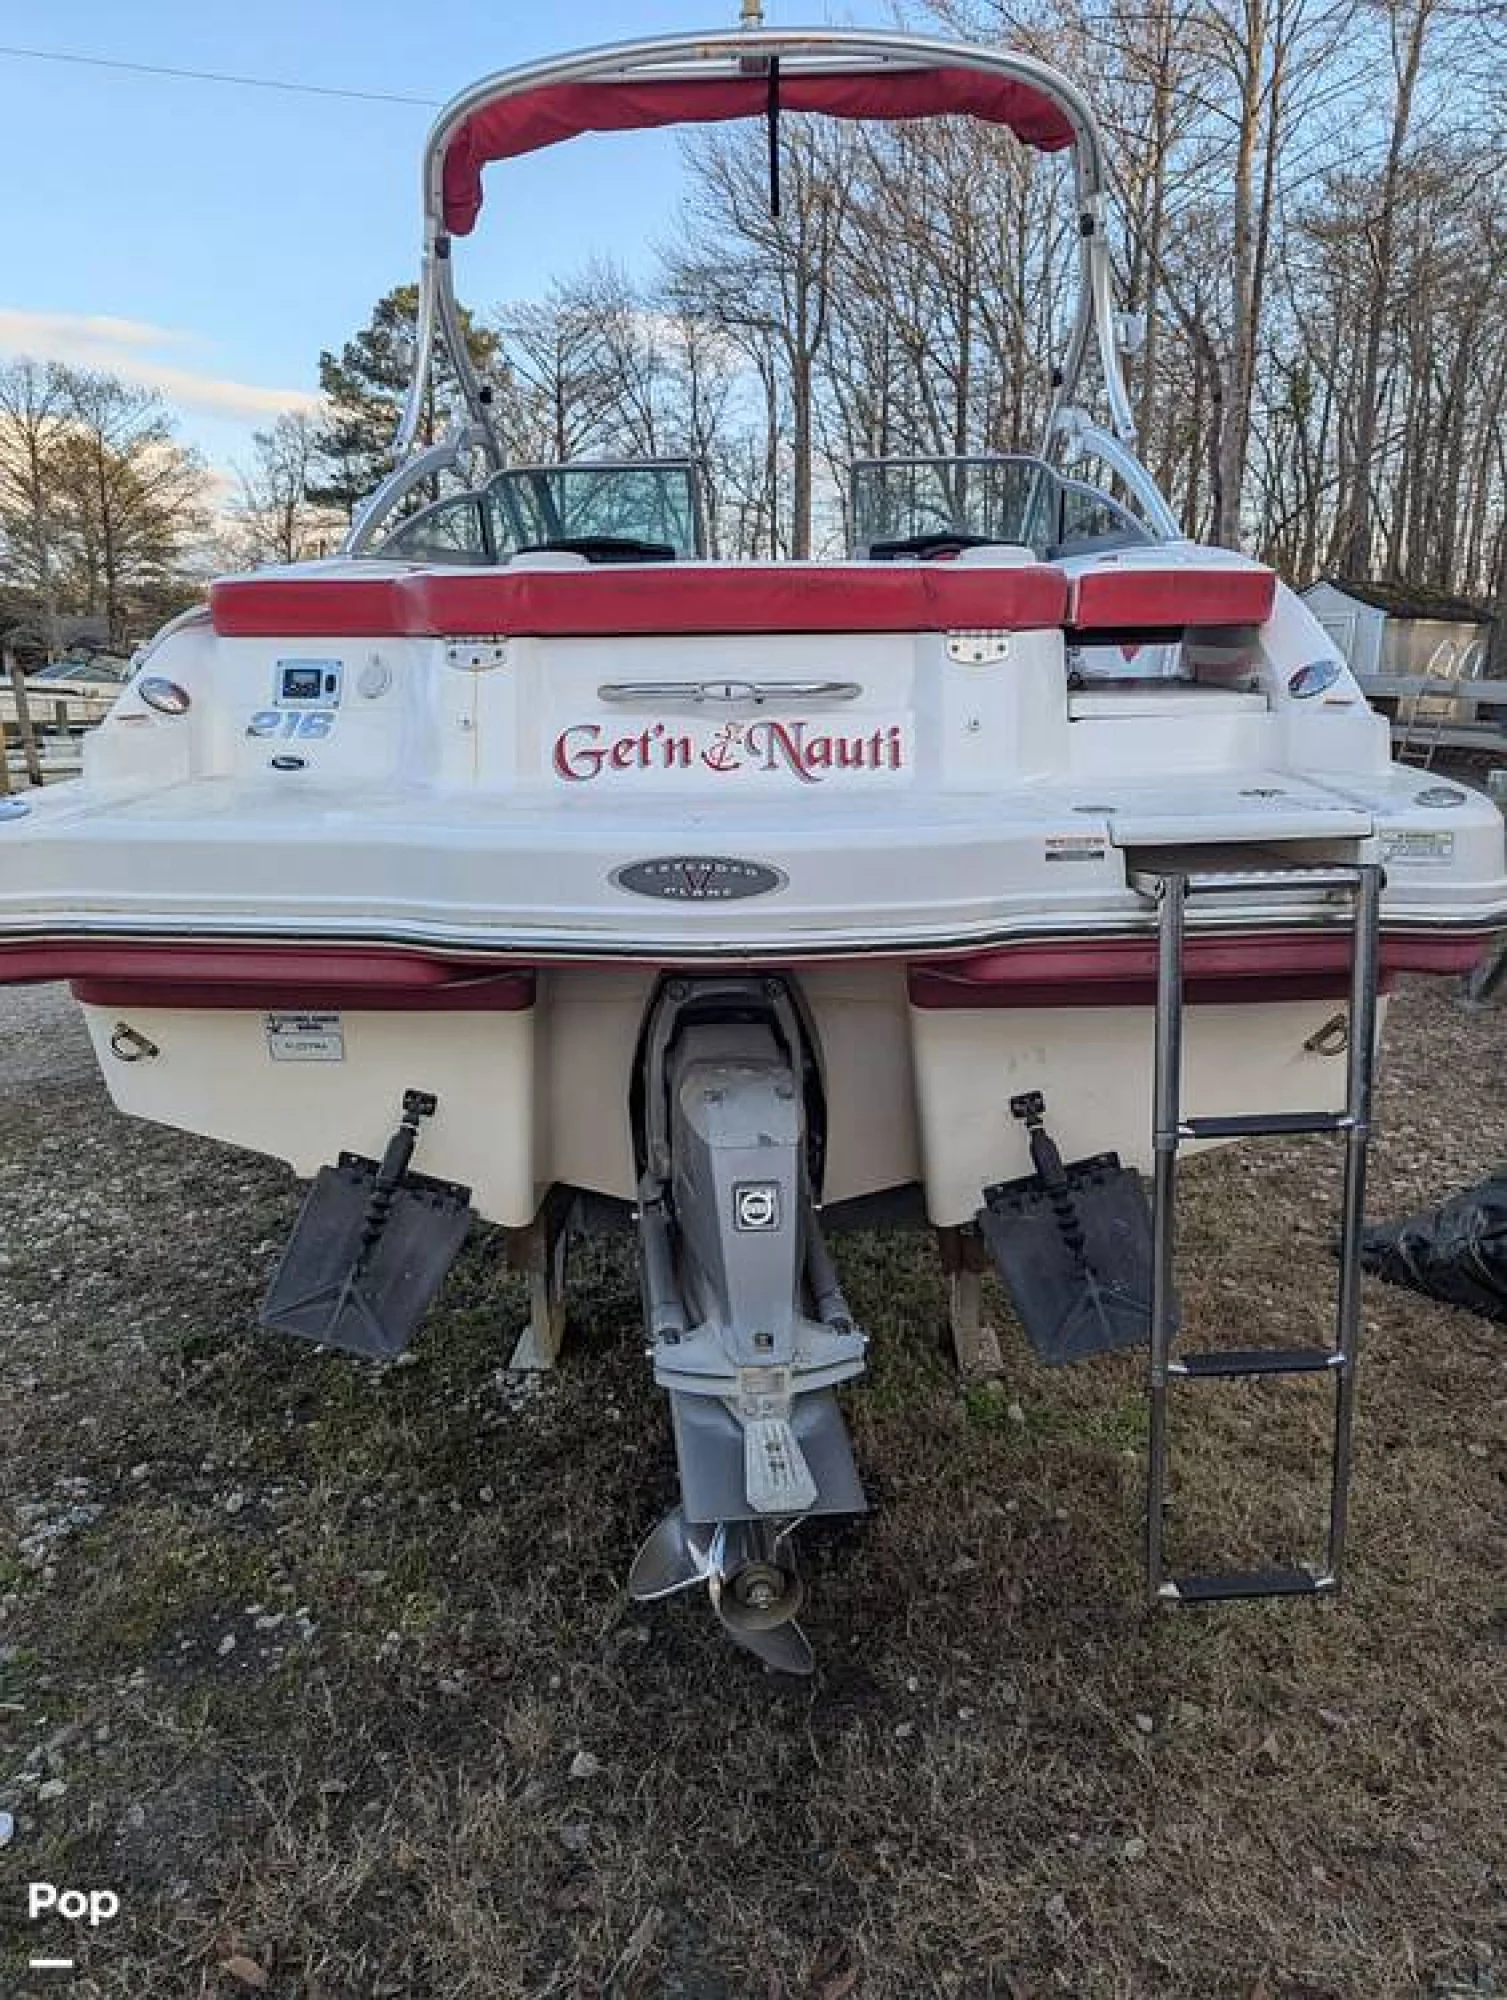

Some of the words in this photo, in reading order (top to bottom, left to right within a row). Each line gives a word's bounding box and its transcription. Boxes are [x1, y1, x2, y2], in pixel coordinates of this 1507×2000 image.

[246, 711, 336, 739] 216
[552, 723, 692, 782] Get'n
[745, 721, 902, 784] Nauti
